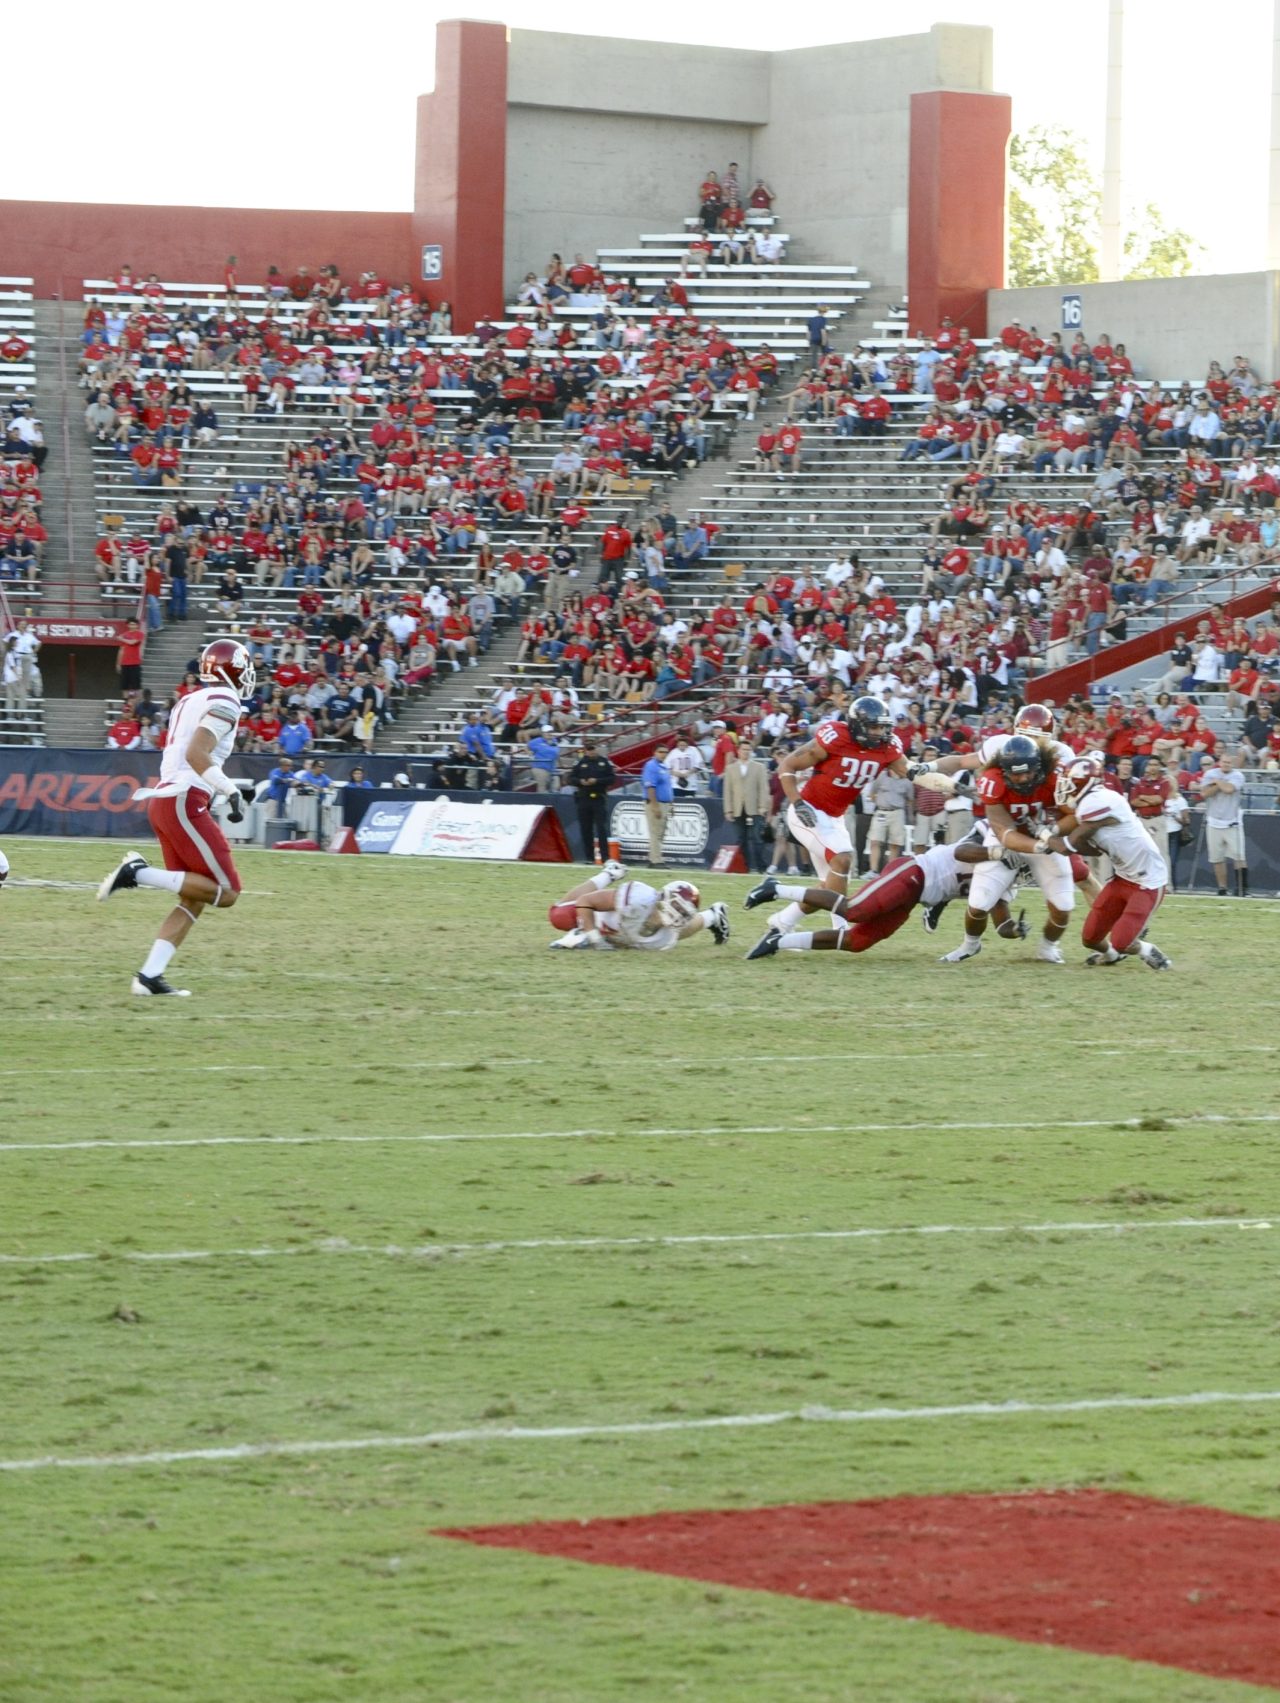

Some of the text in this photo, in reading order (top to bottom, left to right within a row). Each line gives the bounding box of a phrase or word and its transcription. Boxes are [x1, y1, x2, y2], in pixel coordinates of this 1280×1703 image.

[424, 252, 440, 273] 15
[1062, 300, 1080, 323] 16
[49, 624, 92, 637] SECTION
[817, 724, 839, 745] 38
[832, 756, 880, 789] 38
[976, 776, 996, 798] 31
[621, 817, 645, 836] SOL
